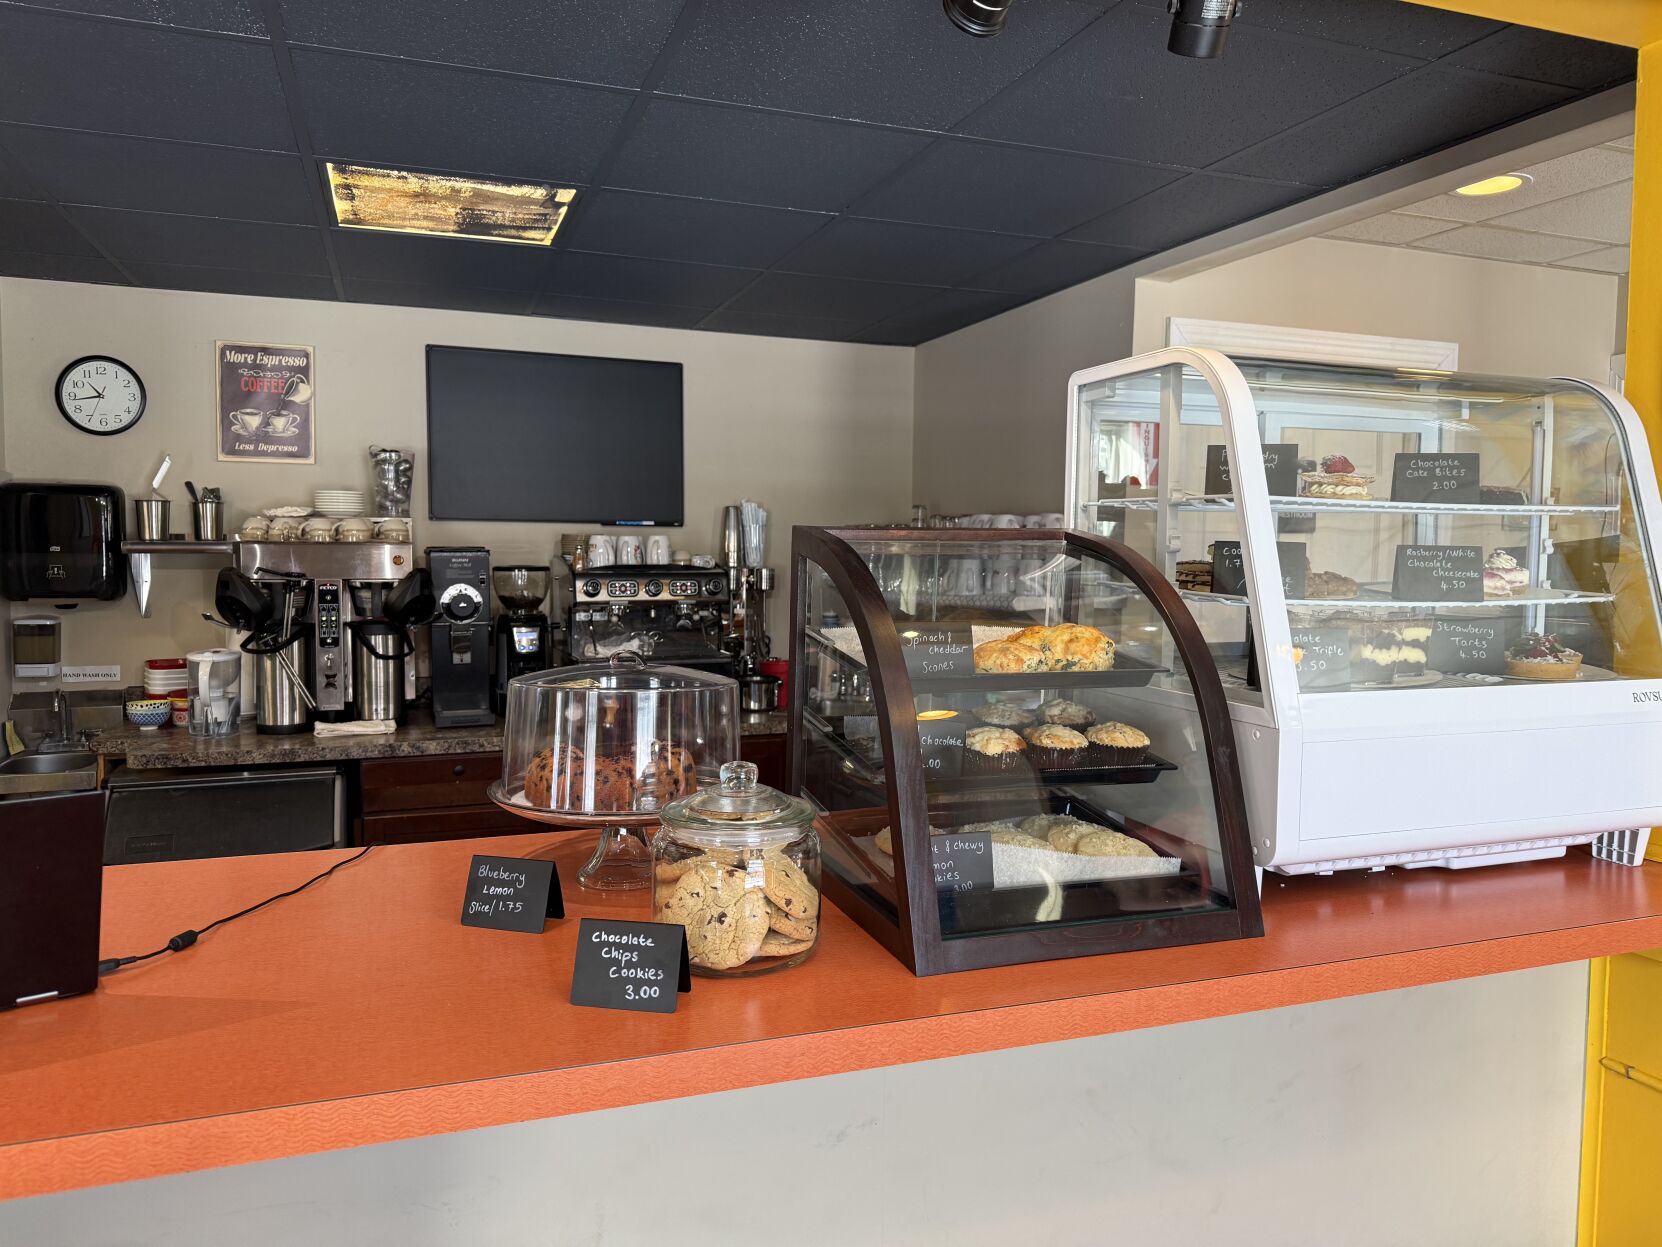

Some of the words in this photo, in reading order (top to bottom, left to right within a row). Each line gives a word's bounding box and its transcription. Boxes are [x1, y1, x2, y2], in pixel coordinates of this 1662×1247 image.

[224, 350, 254, 363] More
[256, 352, 307, 367] Espresso
[83, 370, 91, 378] 11
[95, 366, 106, 375] 12
[72, 380, 84, 388] 10
[122, 379, 131, 388] 2
[241, 376, 286, 393] COFFEE
[68, 391, 77, 401] 9
[128, 393, 136, 402] 3
[74, 404, 82, 413] 8
[124, 406, 132, 414] 4
[86, 414, 93, 423] 7
[100, 417, 108, 426] 6
[113, 414, 122, 423] 5
[235, 441, 254, 451] Less
[258, 442, 298, 453] Depresso
[1410, 459, 1460, 468] Chocolate
[1406, 470, 1428, 478] Cake
[1435, 467, 1466, 476] Bites
[1432, 480, 1457, 490] 2.00
[1406, 548, 1443, 560] Rasberry
[1225, 559, 1241, 568] 1.7
[1407, 559, 1452, 568] Chocolate
[1441, 581, 1466, 591] 4.50
[1437, 621, 1494, 639] Strawberry
[1450, 637, 1488, 648] Tarts
[1312, 645, 1344, 657] Trifle
[1459, 650, 1487, 659] 4.50
[922, 661, 954, 673] Scones
[921, 734, 964, 747] Chocolate
[953, 839, 984, 855] chewy
[478, 865, 526, 889] Blueberry
[483, 885, 514, 896] Lemon
[953, 880, 973, 893] 3.00
[498, 901, 524, 913] 1.75
[592, 931, 655, 947] Chocolate
[601, 946, 638, 968] Chips
[609, 966, 664, 981] Cookies
[625, 984, 660, 1000] 3.00
